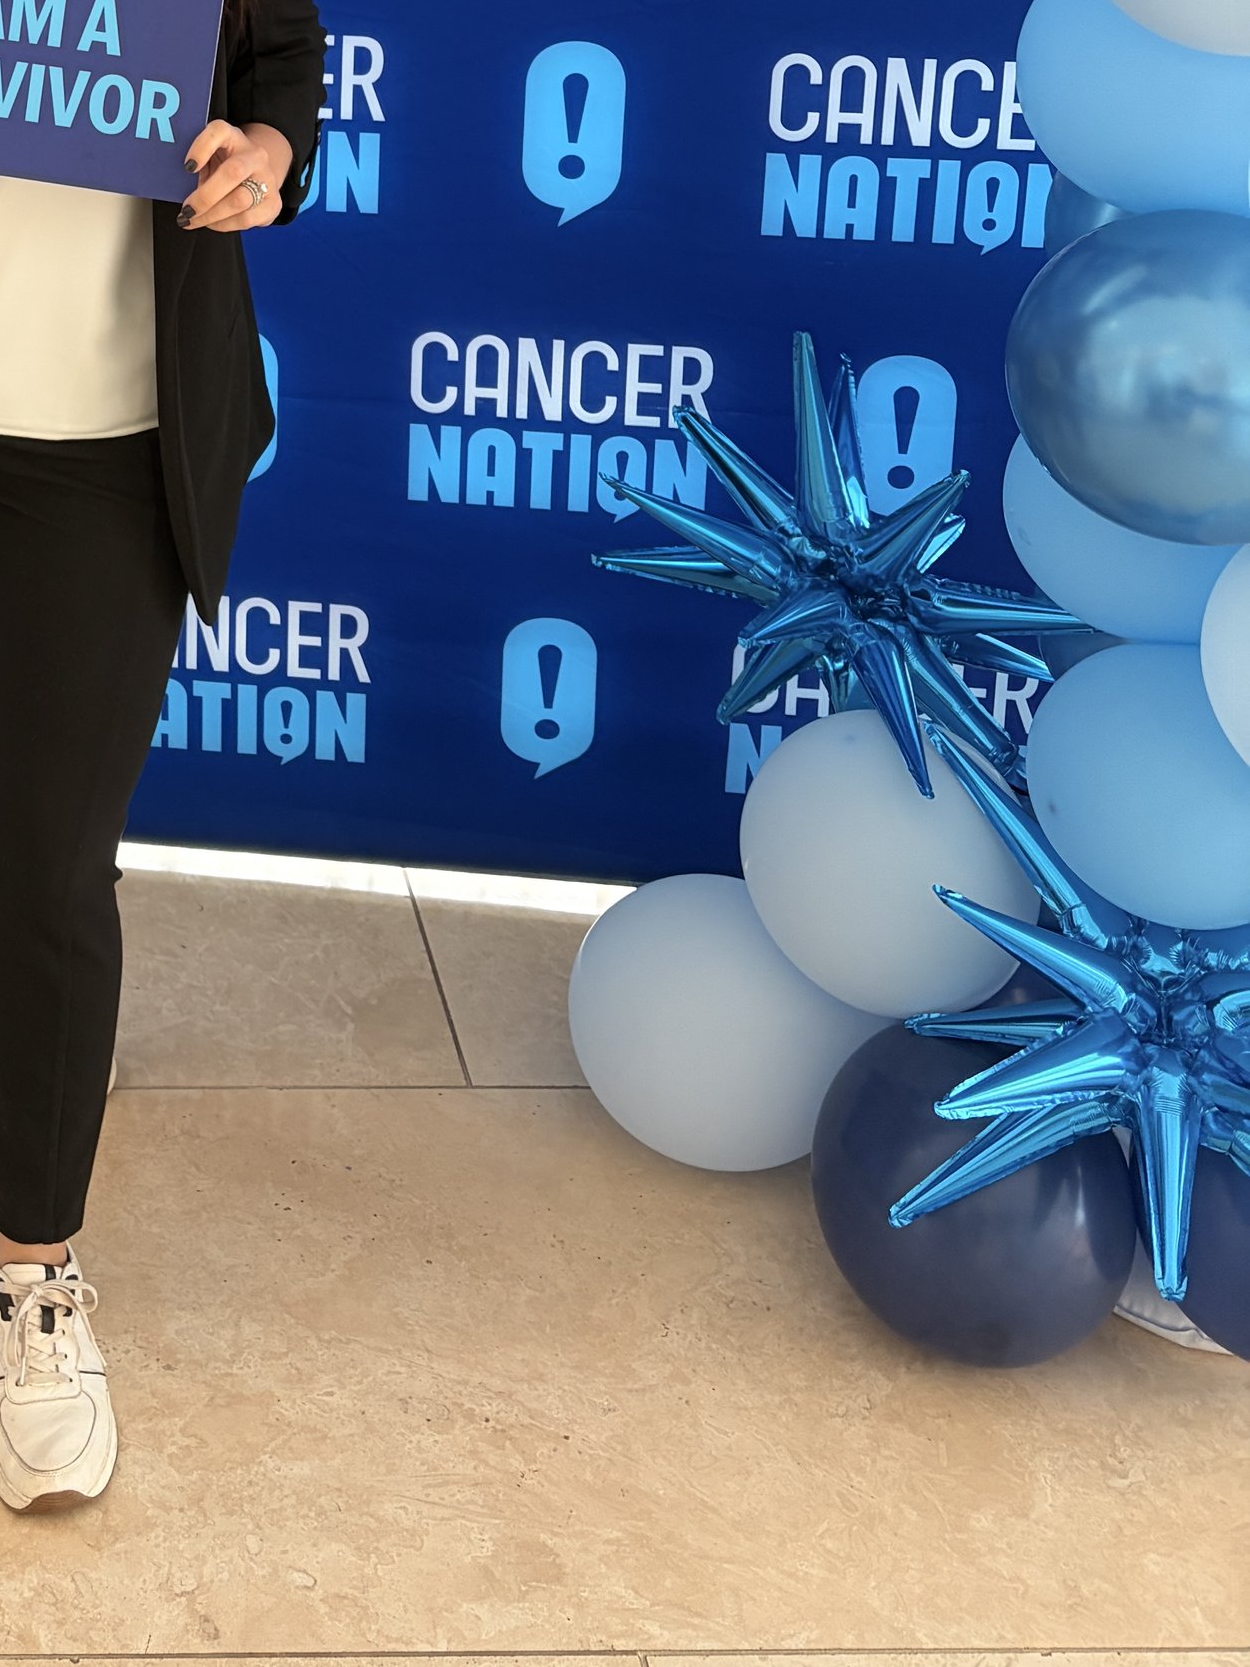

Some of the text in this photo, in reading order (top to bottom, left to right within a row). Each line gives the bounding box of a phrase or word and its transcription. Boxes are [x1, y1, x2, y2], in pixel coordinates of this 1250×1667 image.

[768, 52, 1036, 151] CANCE
[410, 331, 714, 429] CANCER
[407, 423, 707, 524] NATION
[171, 591, 372, 684] NCER
[150, 678, 367, 766] ATION
